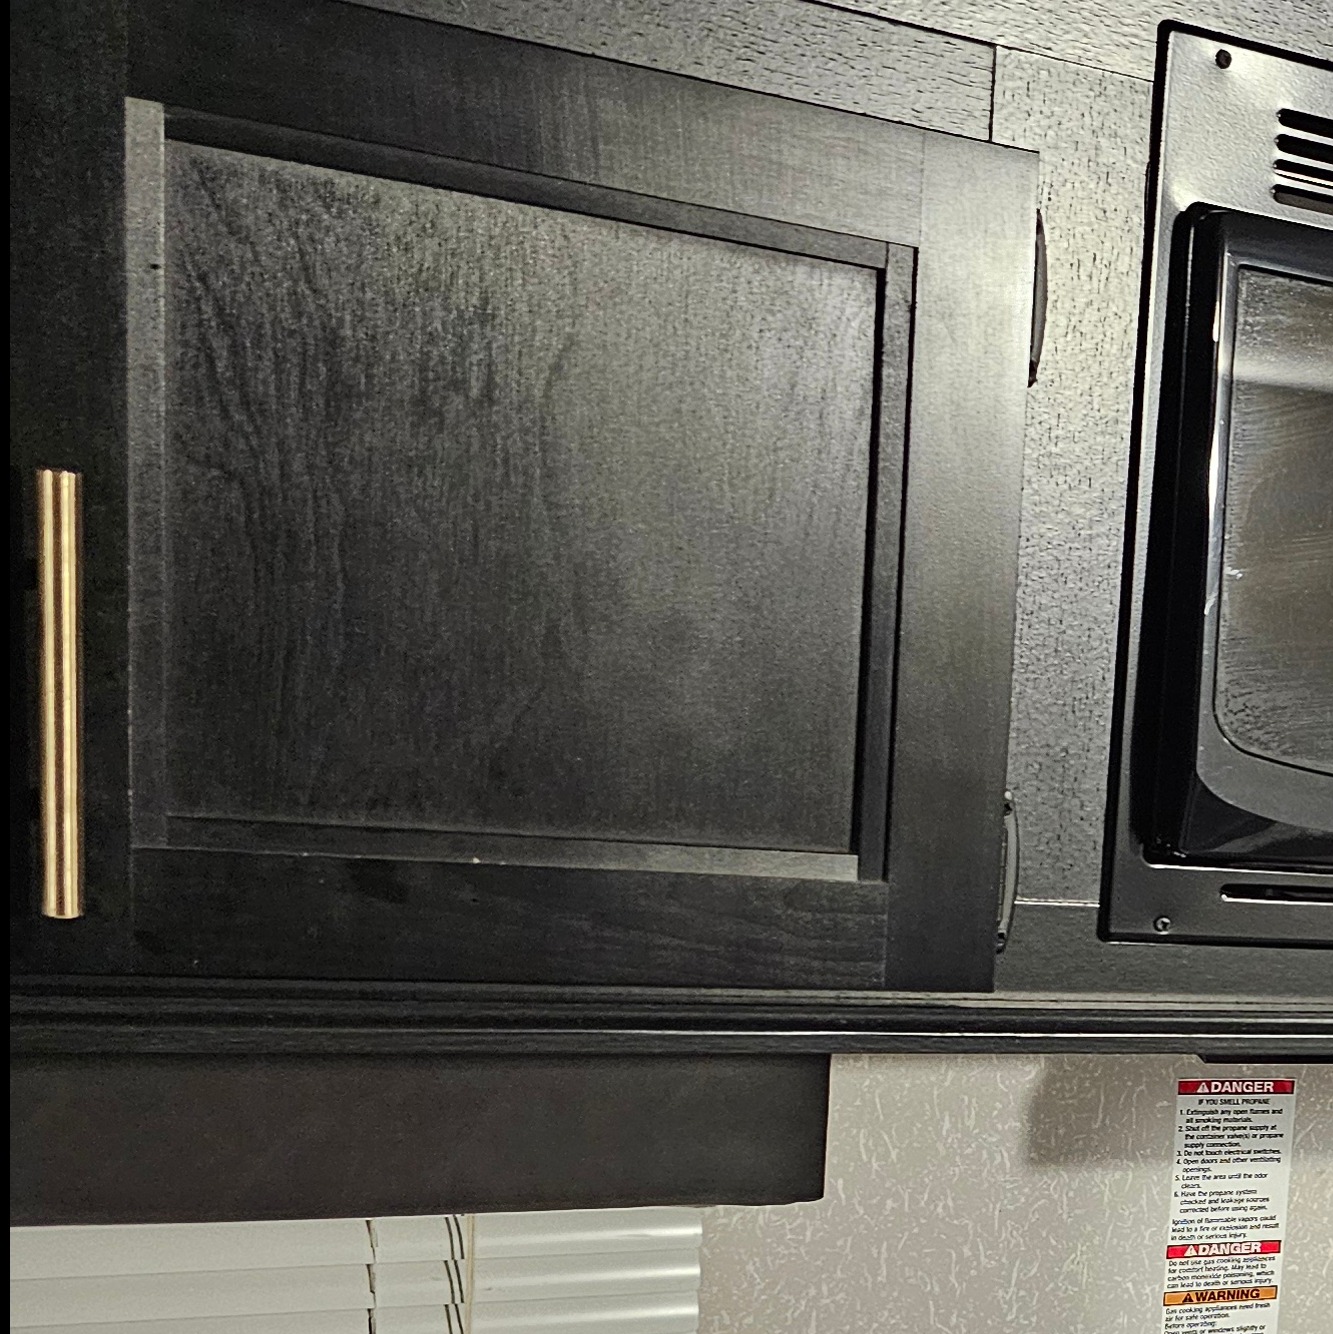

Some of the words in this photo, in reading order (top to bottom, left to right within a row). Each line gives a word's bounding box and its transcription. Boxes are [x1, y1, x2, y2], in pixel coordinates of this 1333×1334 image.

[1211, 1082, 1274, 1092] DANGER
[1198, 1242, 1262, 1255] DANGER
[1195, 1289, 1260, 1302] WARNING
